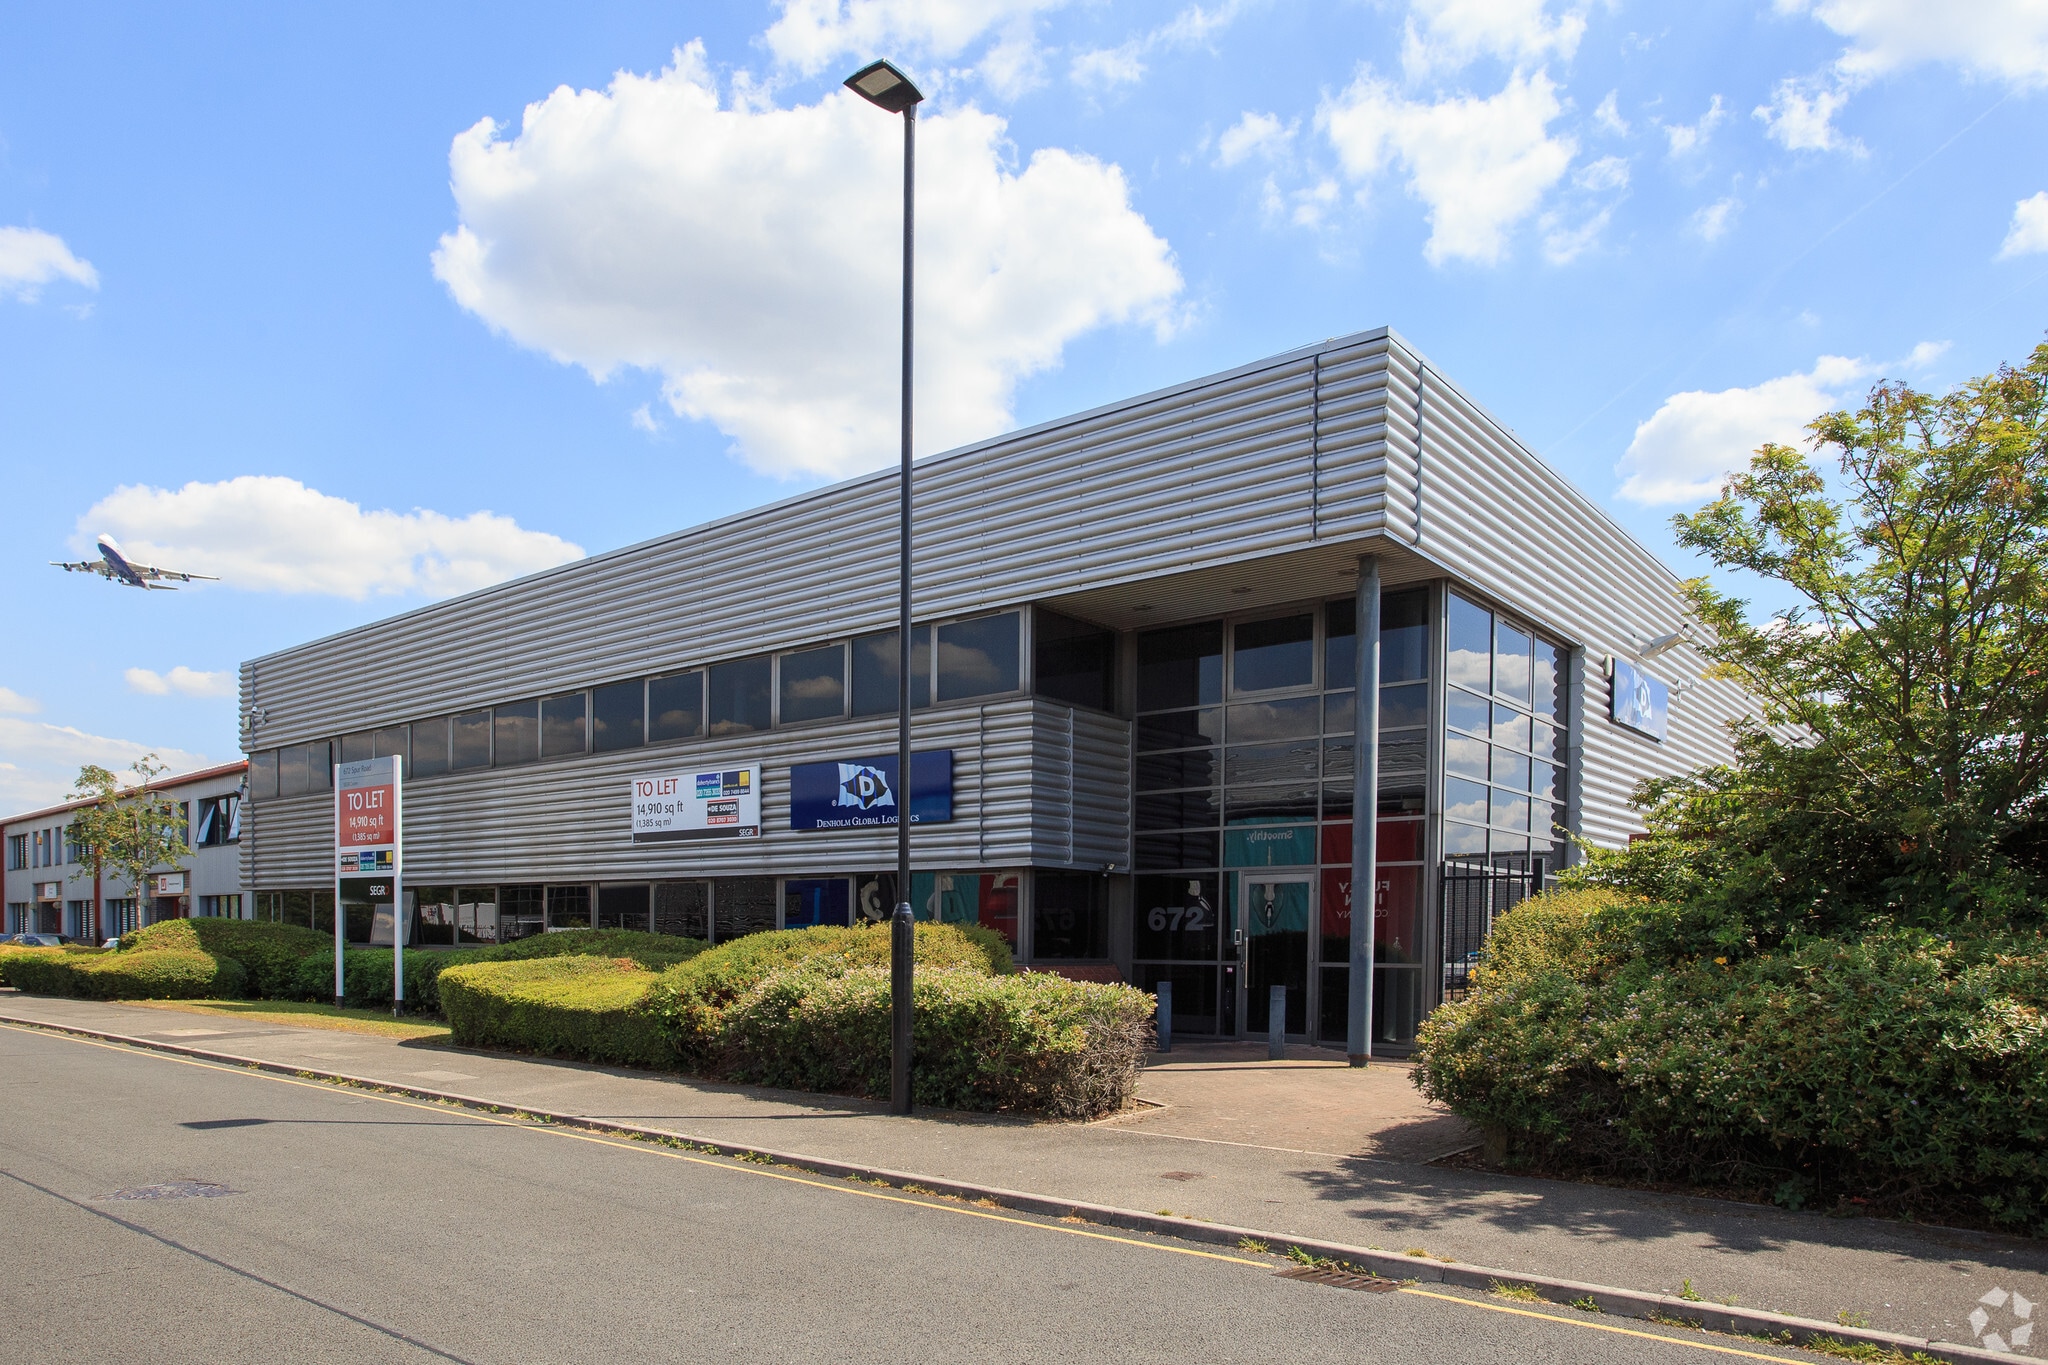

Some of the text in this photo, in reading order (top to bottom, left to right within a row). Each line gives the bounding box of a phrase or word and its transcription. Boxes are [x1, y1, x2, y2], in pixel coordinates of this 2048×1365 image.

[351, 766, 360, 775] Spur
[361, 764, 372, 772] Road
[636, 778, 678, 797] TO LET
[859, 776, 874, 796] D
[347, 789, 385, 811] TO LET
[637, 800, 683, 816] 14,910 sq ft
[349, 814, 384, 829] 14,910 sq ft
[636, 817, 672, 828] (1,385 sq m)
[817, 814, 920, 828] DENHOLM GLOBAL LOGCS
[366, 833, 373, 842] sq
[373, 831, 380, 840] m)
[738, 827, 757, 837] SEGRO
[369, 884, 390, 896] SEGRO
[1147, 906, 1204, 932] 672
